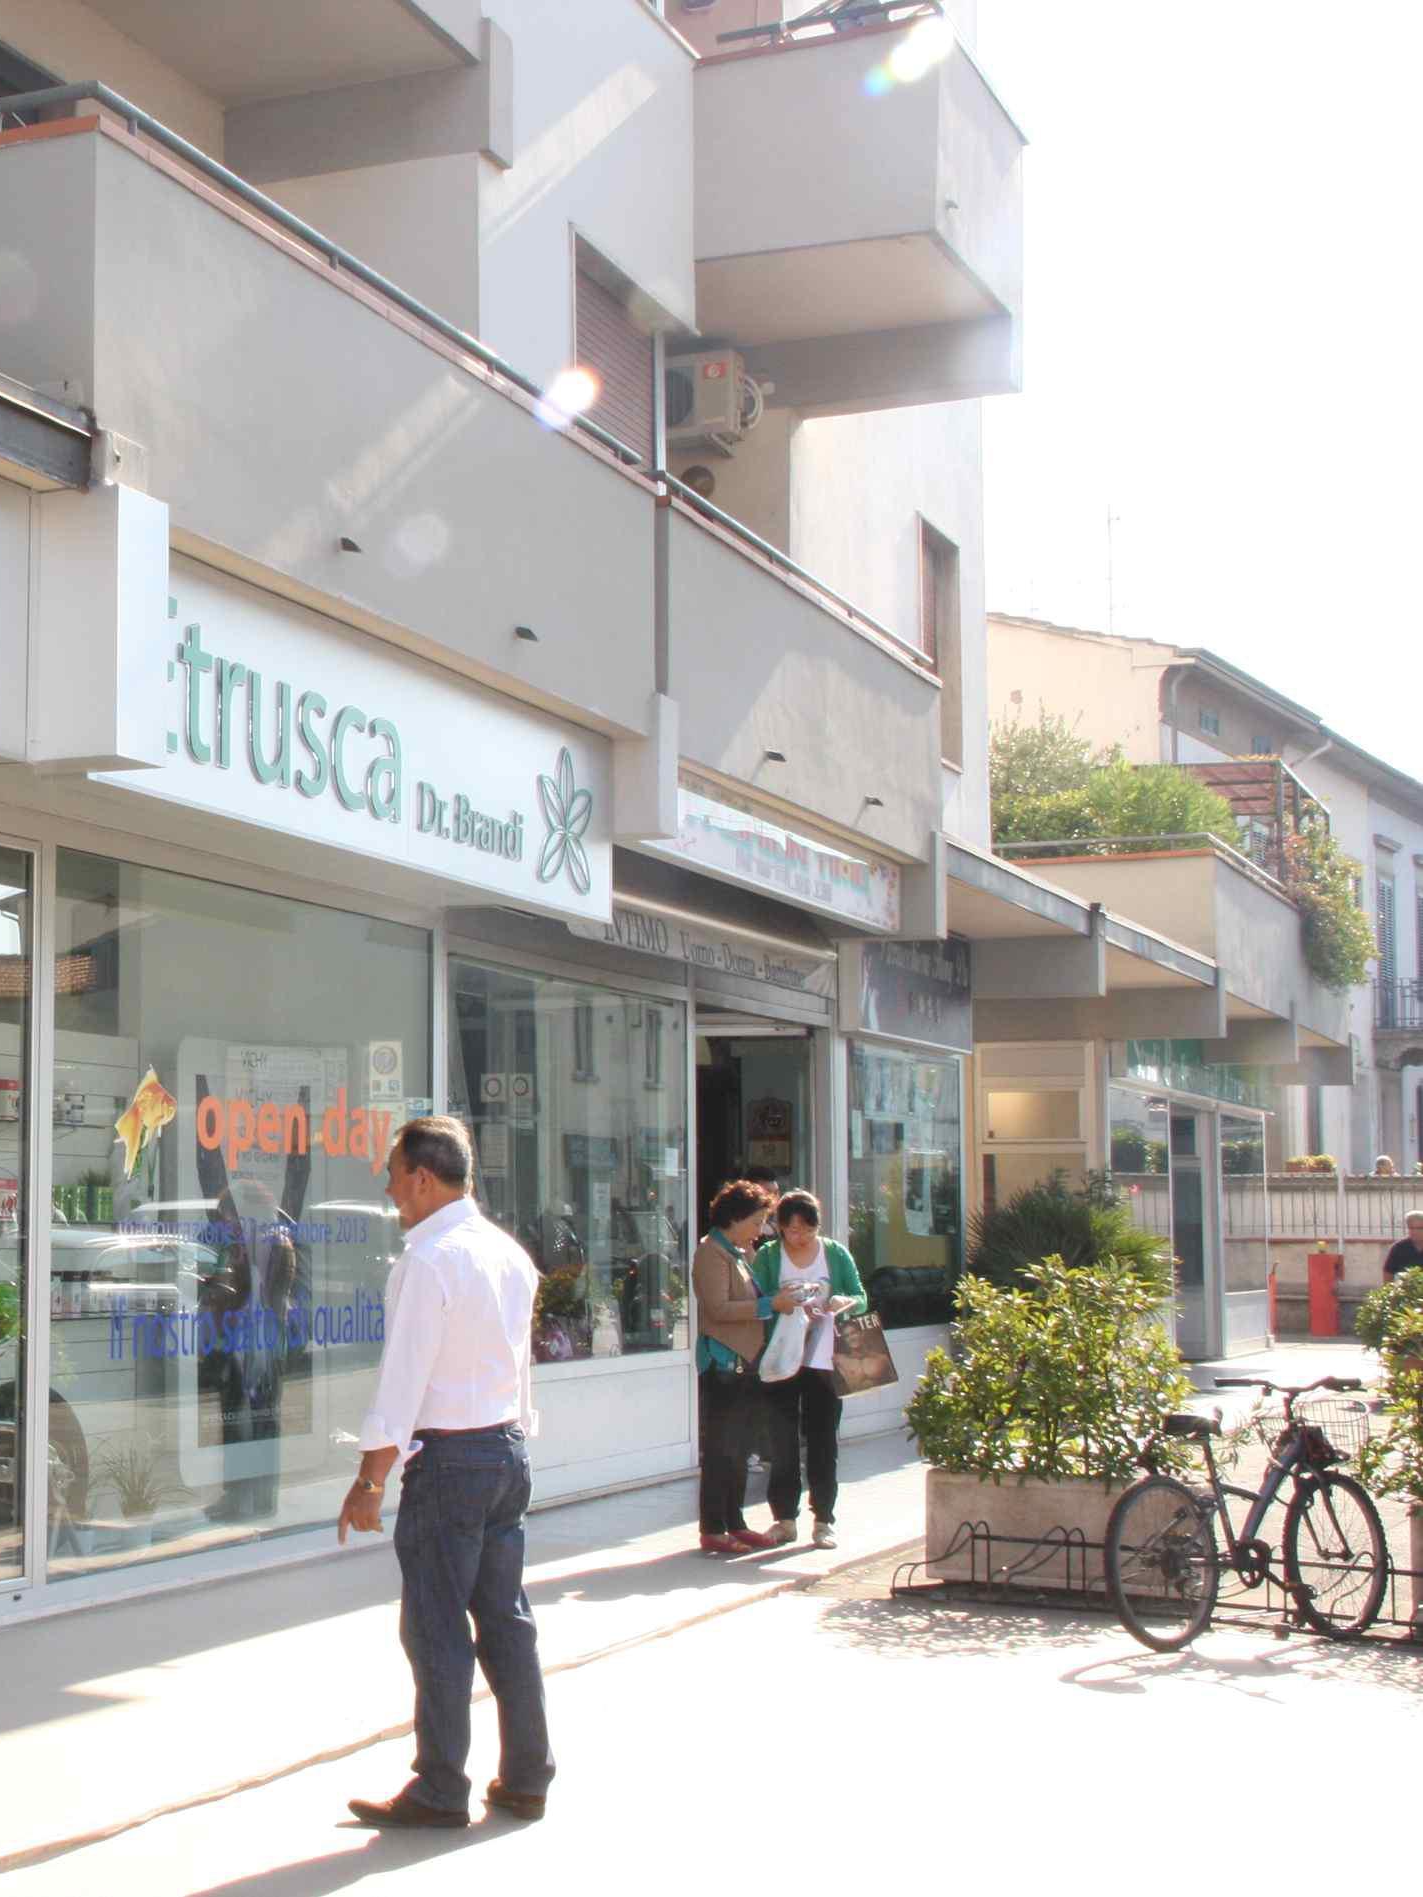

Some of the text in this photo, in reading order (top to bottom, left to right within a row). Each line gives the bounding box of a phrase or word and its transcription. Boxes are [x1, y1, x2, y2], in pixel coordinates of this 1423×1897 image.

[166, 597, 524, 862] trusca Dr. Brandi
[603, 910, 669, 954] INTIMO
[197, 1087, 392, 1176] open day
[336, 1215, 368, 1243] 2013
[132, 1306, 216, 1357] nostro
